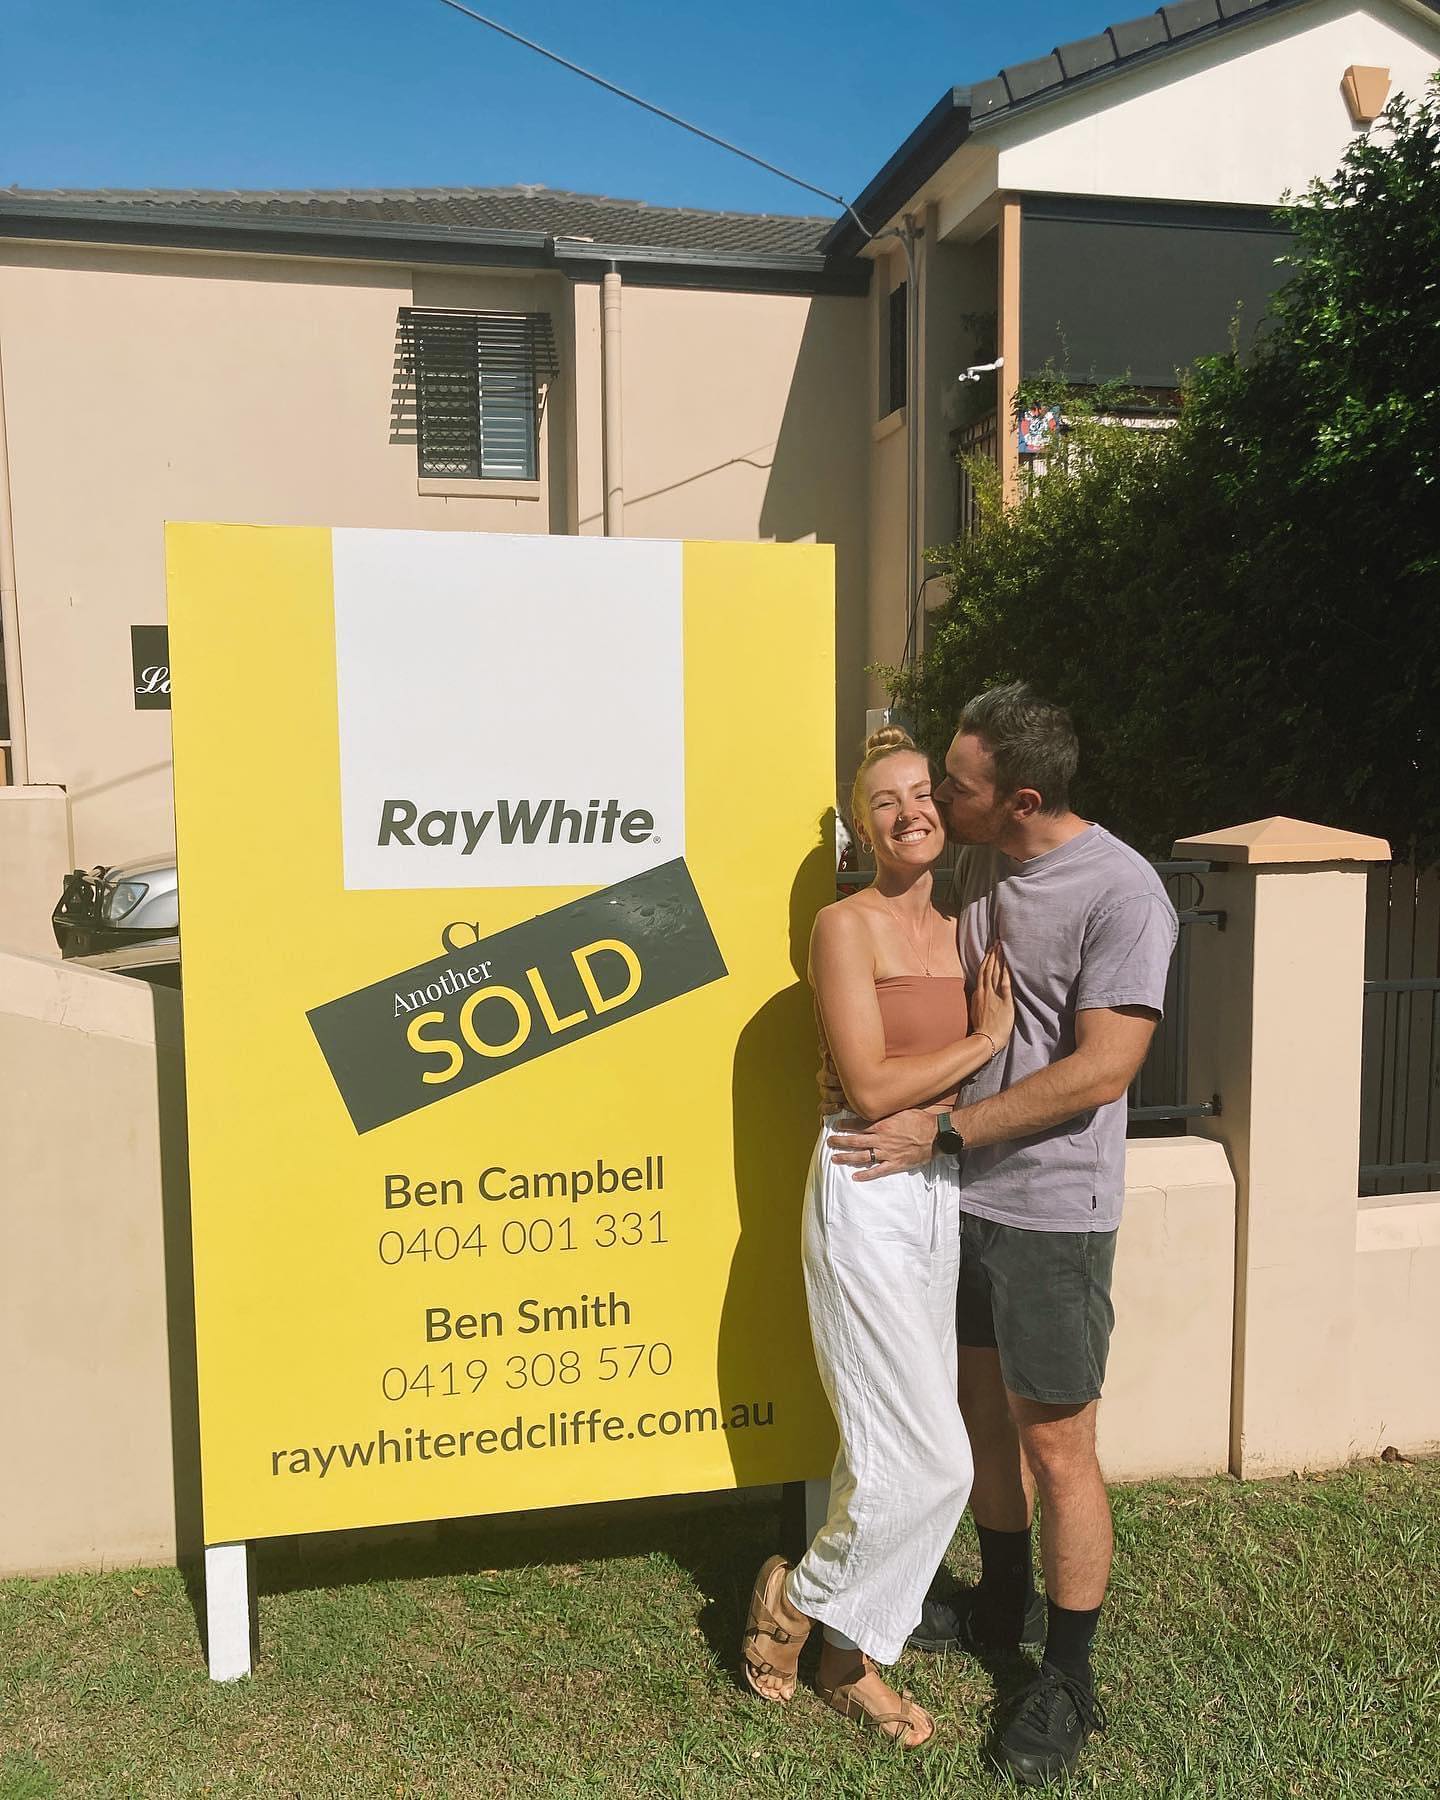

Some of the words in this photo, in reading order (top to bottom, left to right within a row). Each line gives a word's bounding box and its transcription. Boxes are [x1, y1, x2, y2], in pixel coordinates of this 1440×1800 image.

[393, 960, 493, 1018] Another
[406, 938, 642, 1085] SOLD
[384, 1174, 464, 1210] Ben
[478, 1155, 665, 1204] Campbell
[378, 1223, 488, 1266] 0404
[501, 1216, 579, 1255] 001
[595, 1210, 670, 1248] 331
[425, 1307, 503, 1343] Ben
[516, 1291, 632, 1334] Smith
[381, 1359, 488, 1402] 0419
[505, 1350, 581, 1390] 308
[598, 1342, 673, 1381] 570
[270, 1400, 776, 1478] raywhiteredcliffe.com.au
